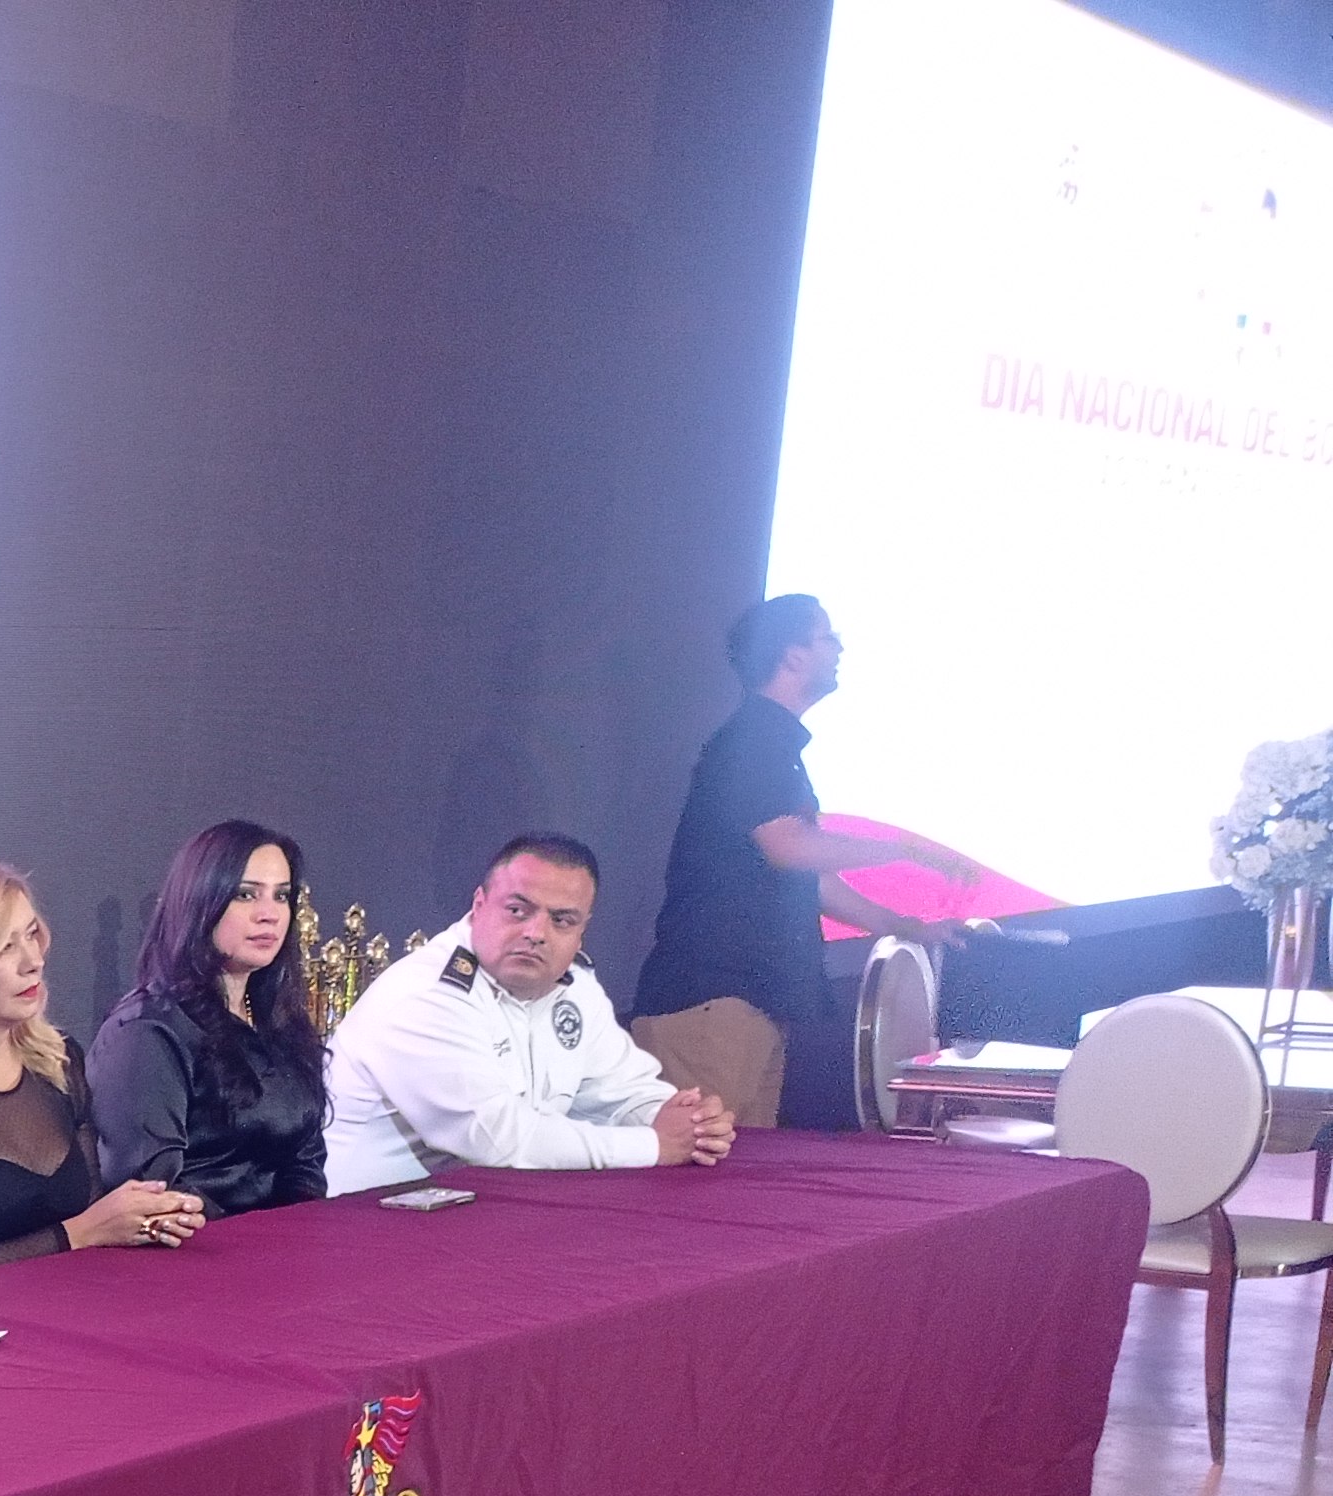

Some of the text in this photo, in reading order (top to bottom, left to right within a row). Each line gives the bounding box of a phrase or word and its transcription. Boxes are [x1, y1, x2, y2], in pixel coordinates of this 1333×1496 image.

[980, 353, 1044, 418] DIA
[1058, 368, 1230, 448] NACIONAL
[1241, 405, 1291, 459] DEL
